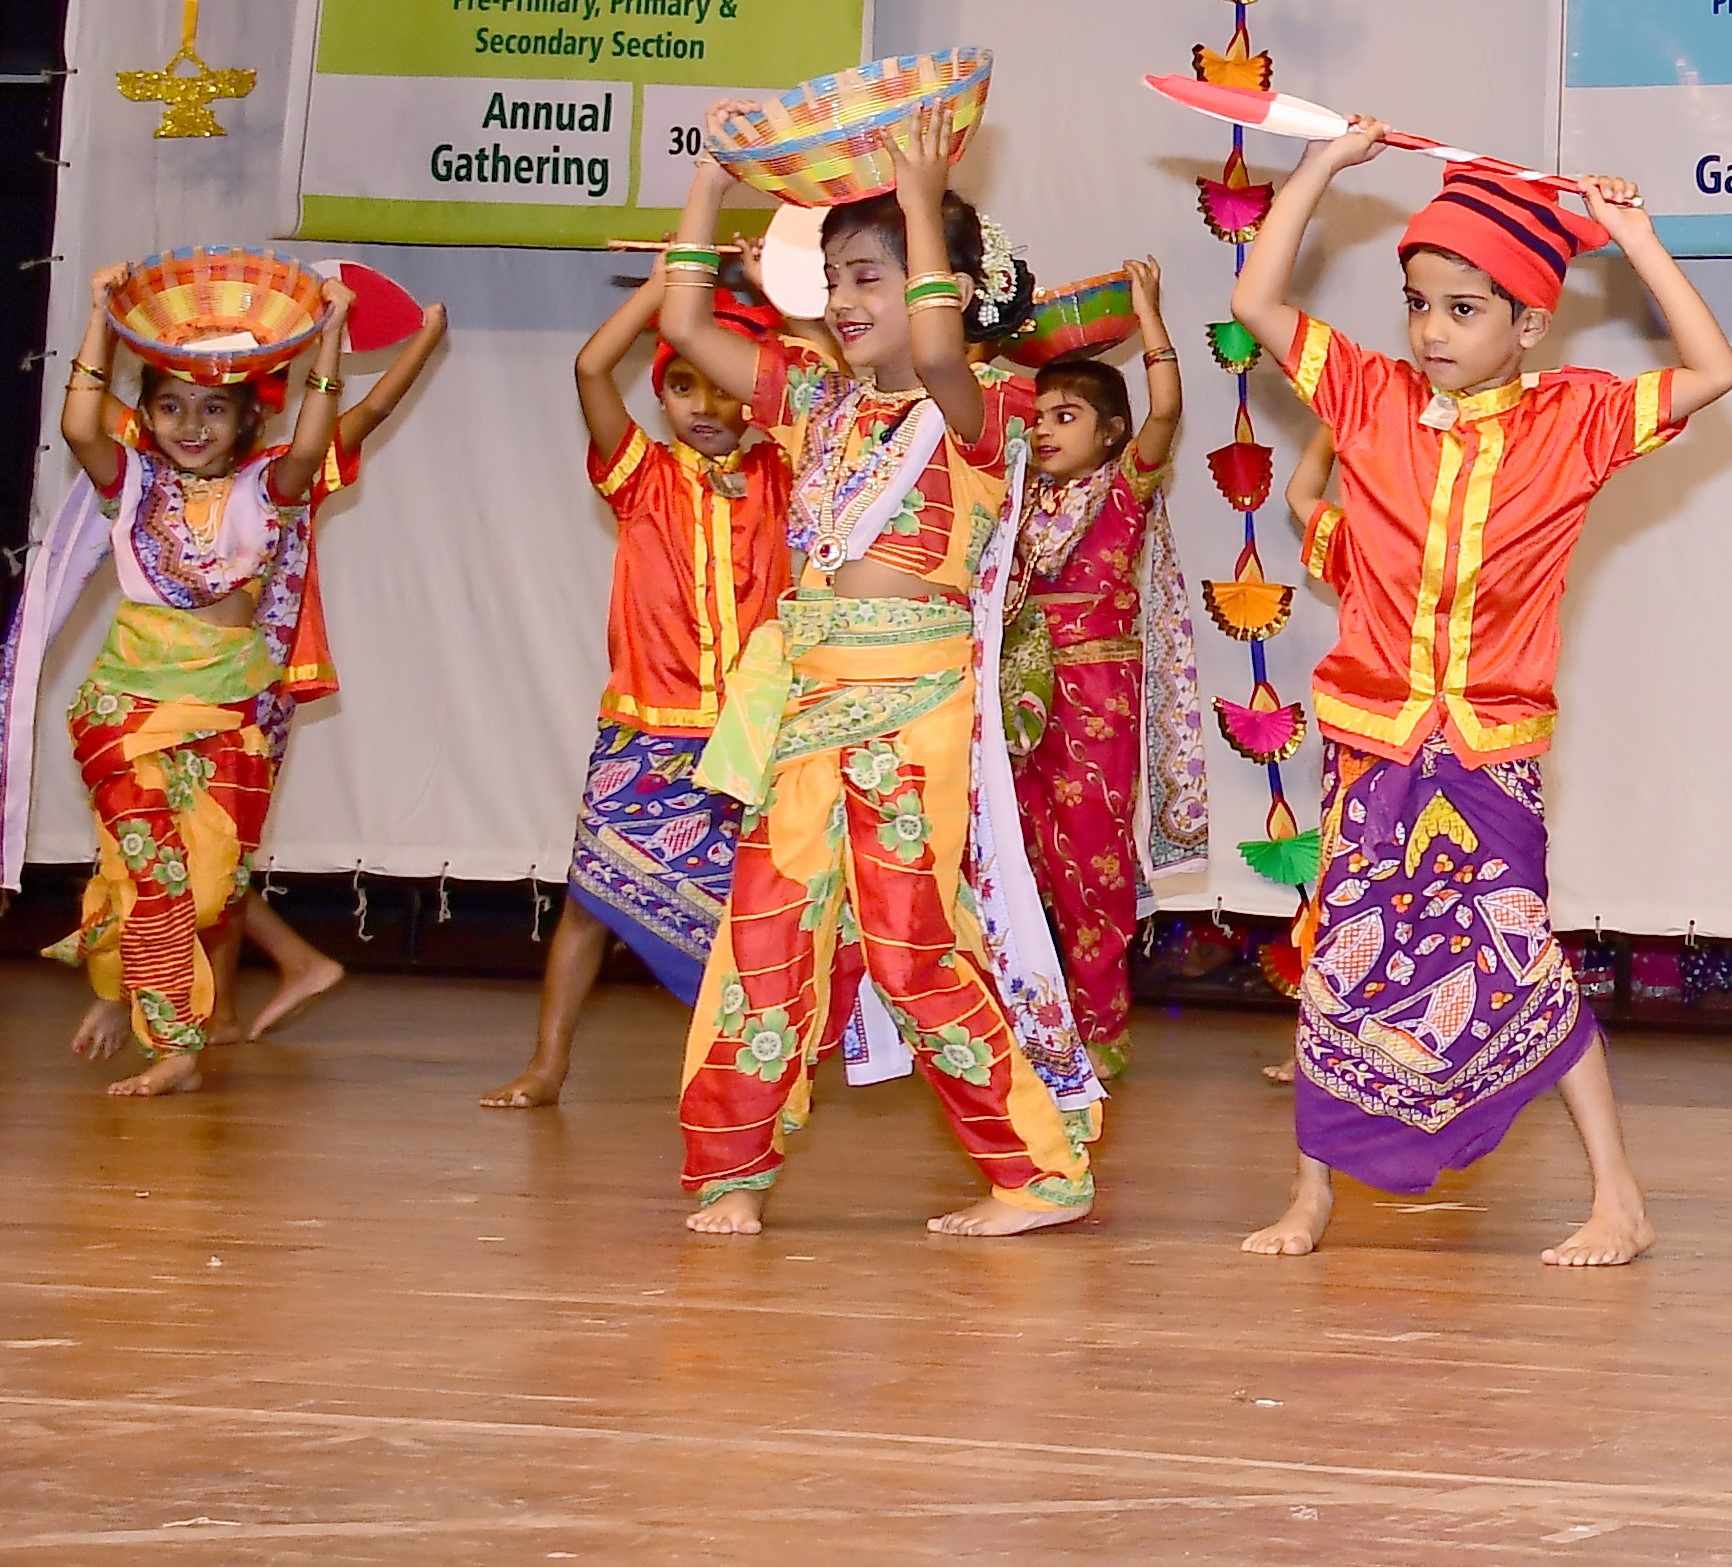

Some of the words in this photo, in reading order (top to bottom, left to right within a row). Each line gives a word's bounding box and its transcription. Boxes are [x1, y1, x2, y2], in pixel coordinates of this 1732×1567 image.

[475, 27, 603, 63] Secondary
[611, 30, 705, 59] Section
[482, 92, 612, 132] Annual
[431, 143, 609, 197] Gathering
